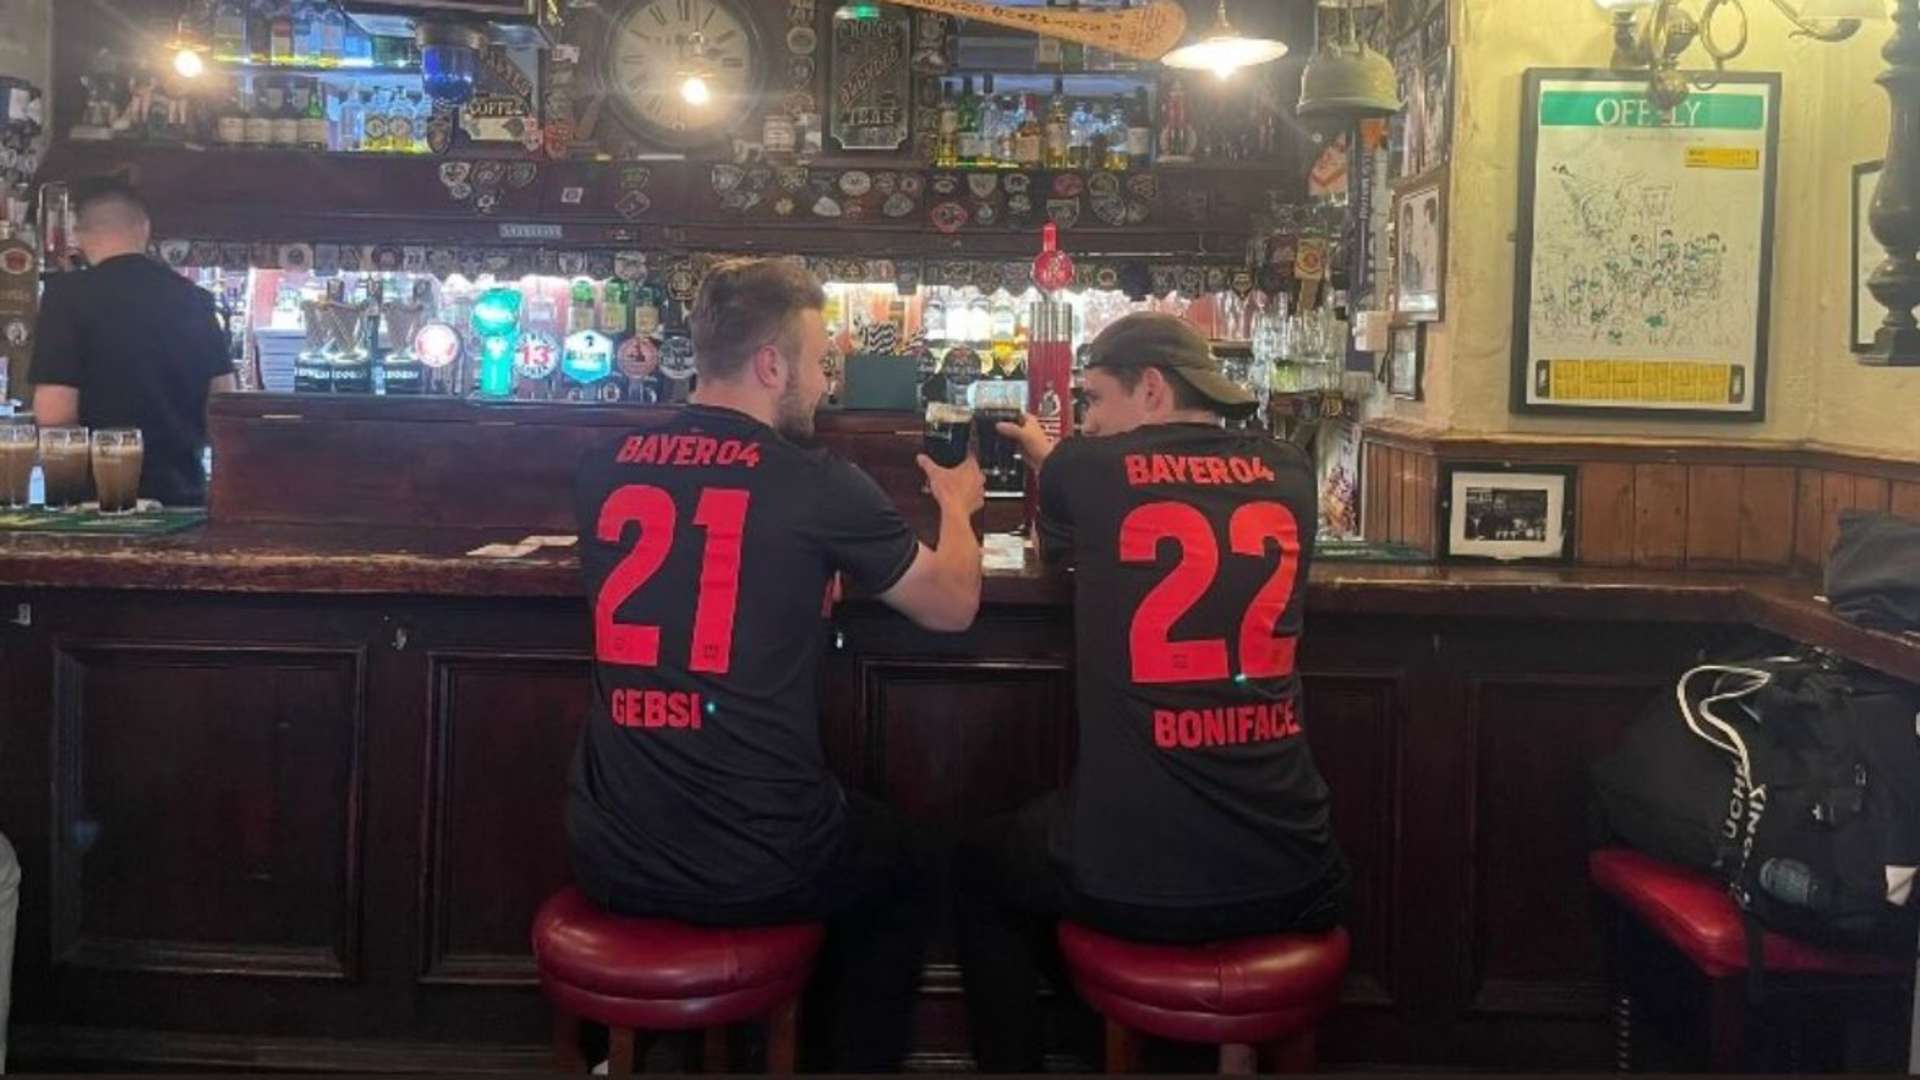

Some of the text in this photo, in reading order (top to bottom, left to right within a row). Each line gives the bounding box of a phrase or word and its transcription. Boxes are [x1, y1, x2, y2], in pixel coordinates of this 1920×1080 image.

[1595, 97, 1702, 126] OFFLY
[595, 484, 750, 674] 21
[1119, 501, 1299, 683] 22
[611, 688, 702, 729] GEBSI
[1153, 700, 1302, 748] BONIFACE
